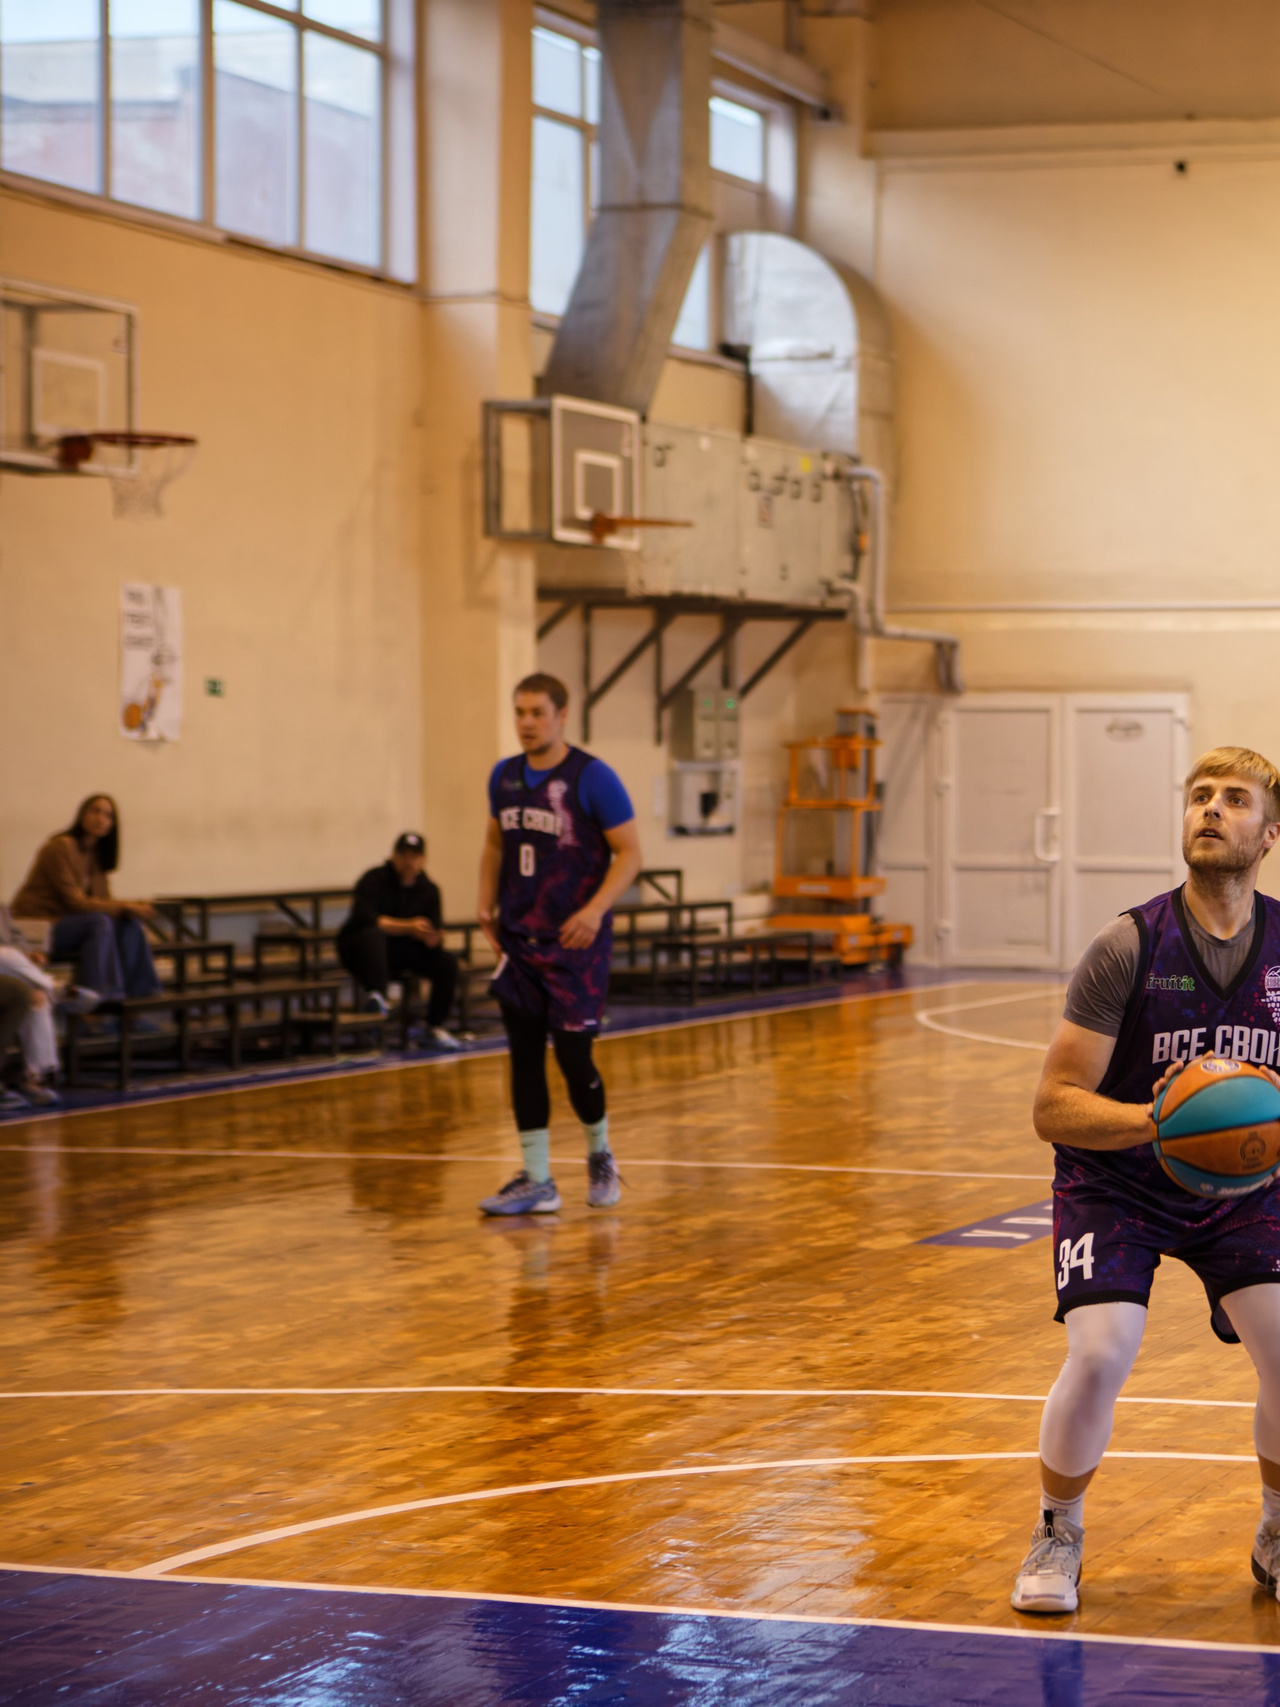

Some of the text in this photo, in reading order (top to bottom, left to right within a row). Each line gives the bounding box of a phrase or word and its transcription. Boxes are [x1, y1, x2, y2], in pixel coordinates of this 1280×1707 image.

[520, 843, 535, 876] 0
[1146, 972, 1196, 991] fruitit
[1152, 1027, 1207, 1064] ВСЕ
[1057, 1232, 1095, 1291] 34
